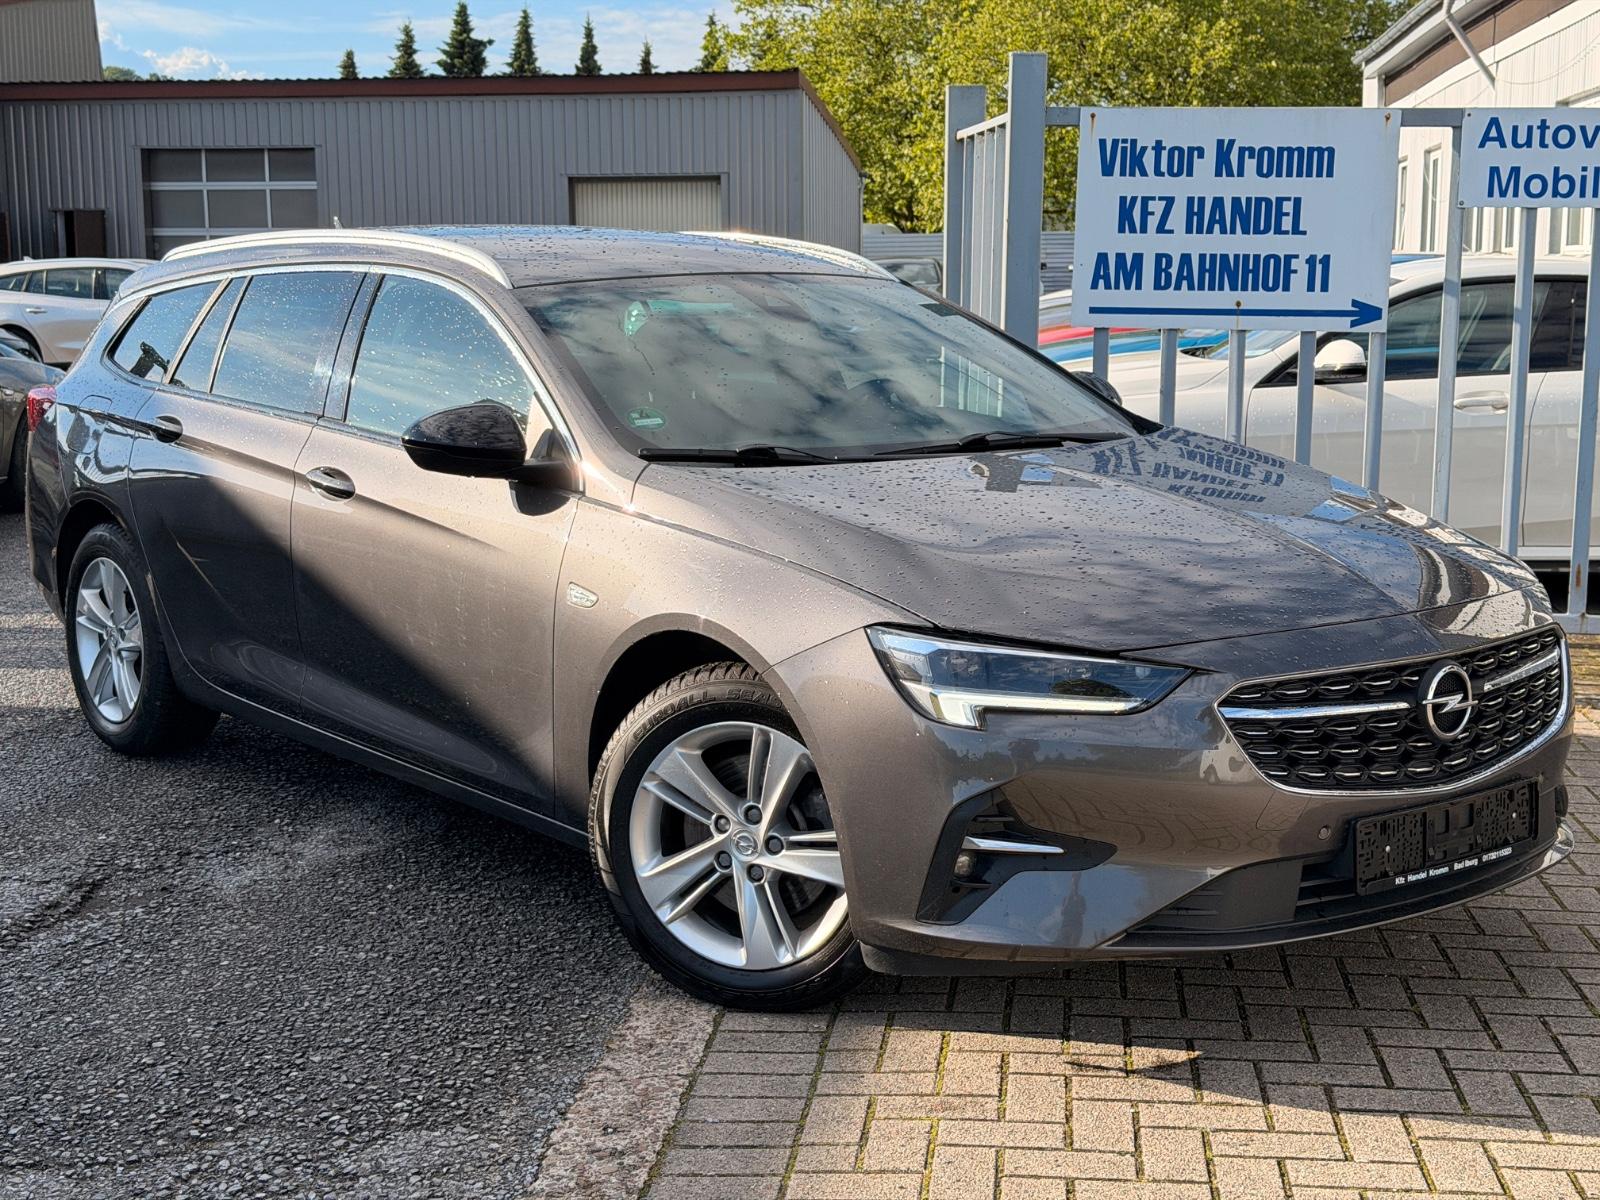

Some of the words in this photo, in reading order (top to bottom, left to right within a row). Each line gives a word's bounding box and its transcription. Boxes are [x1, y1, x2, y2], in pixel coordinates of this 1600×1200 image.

[1098, 138, 1205, 178] Viktor
[1214, 138, 1336, 178] Kromm
[1487, 165, 1600, 199] Mobil
[1117, 195, 1176, 235] KFZ
[1184, 196, 1308, 236] HANDEL
[1090, 252, 1144, 291] AM
[1153, 252, 1300, 293] BAHNHOF
[1305, 254, 1331, 293] 11
[1407, 870, 1428, 882] Handel
[1429, 866, 1449, 877] Kromm
